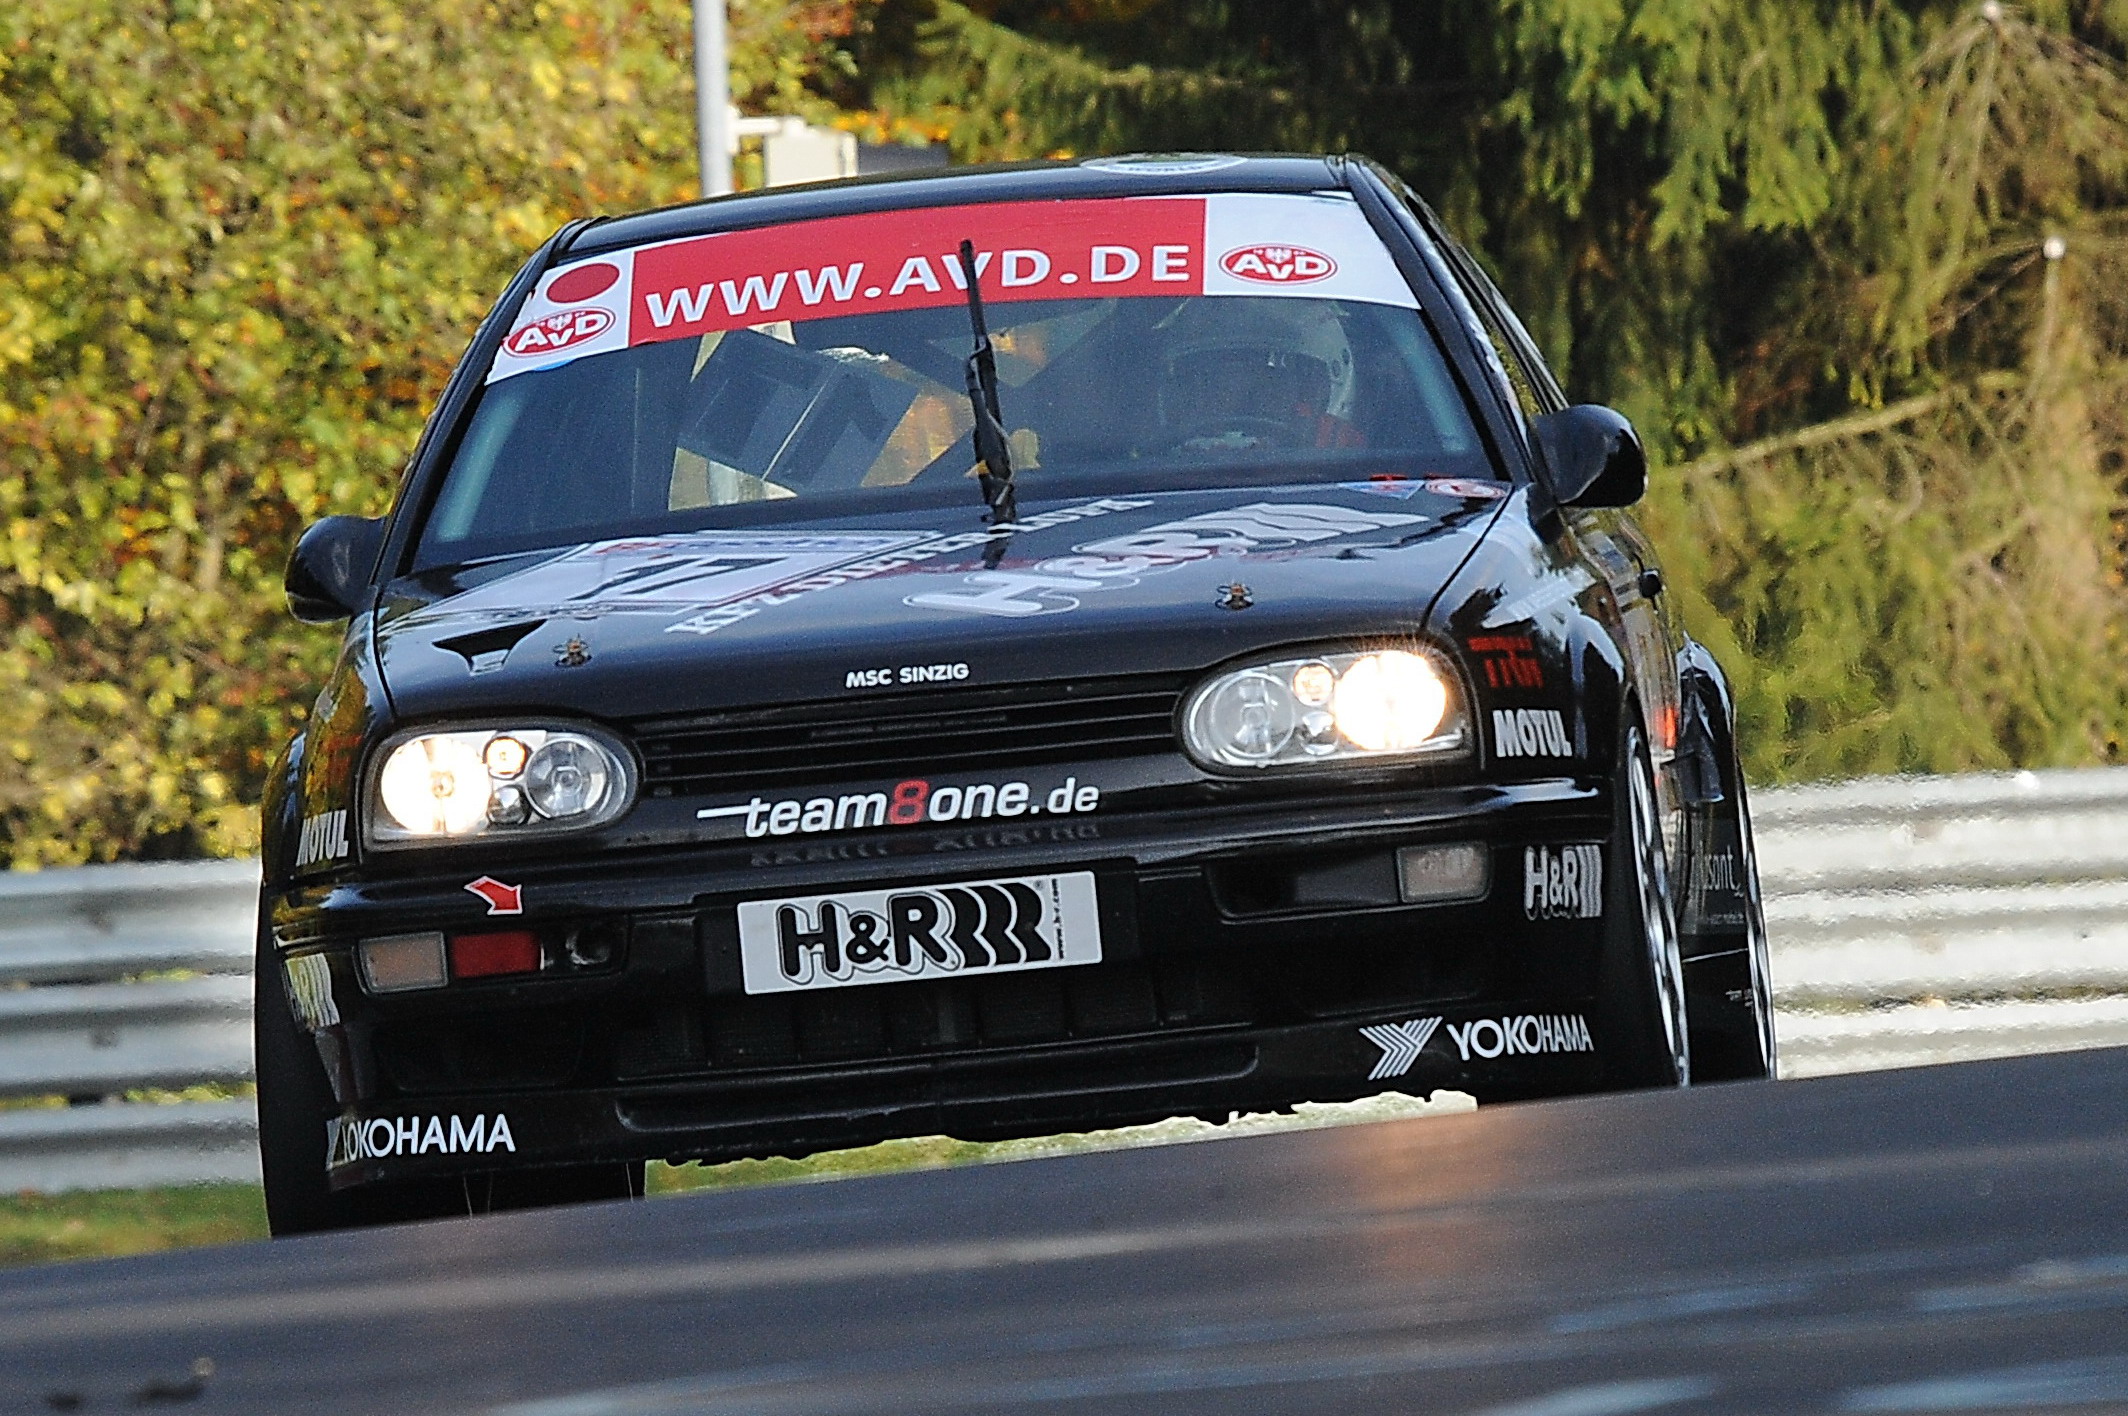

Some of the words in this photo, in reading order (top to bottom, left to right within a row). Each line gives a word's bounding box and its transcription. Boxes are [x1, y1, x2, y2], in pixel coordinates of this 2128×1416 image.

[645, 245, 1190, 328] WWW.AVD.DE
[846, 668, 892, 688] MSC
[899, 663, 970, 684] SINZIG
[1493, 708, 1573, 758] MOTUL
[697, 776, 1099, 838] team8one.de
[296, 809, 350, 867] MOTUL
[1446, 1014, 1595, 1061] YOKOHAMA
